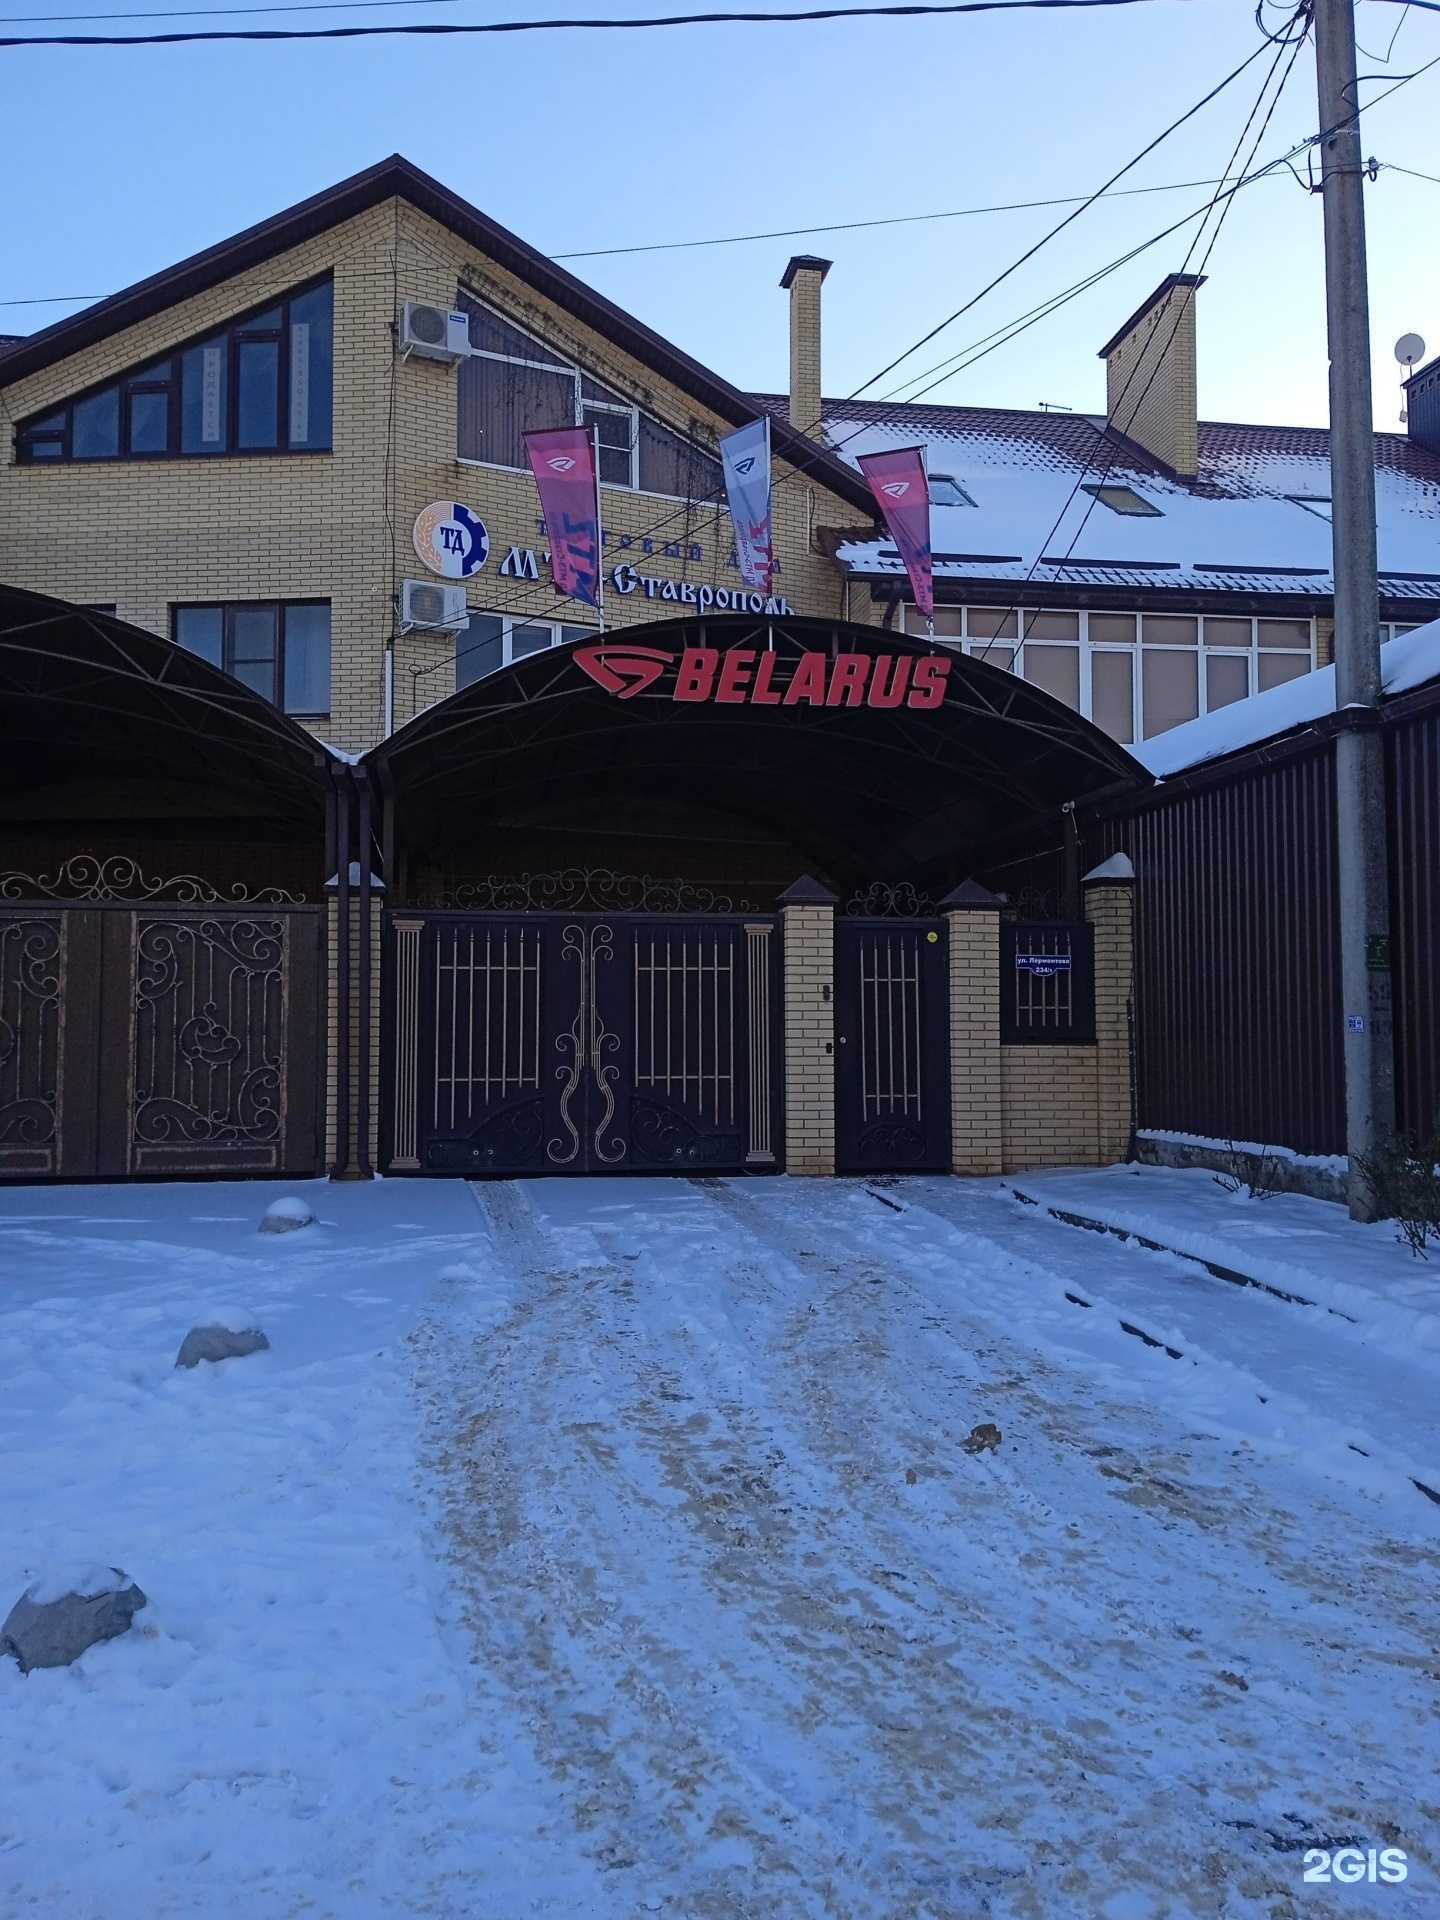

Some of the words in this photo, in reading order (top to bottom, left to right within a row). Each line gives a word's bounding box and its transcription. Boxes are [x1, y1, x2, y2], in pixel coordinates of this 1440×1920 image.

[439, 526, 466, 557] ТД
[499, 545, 796, 616] М-Ставрополь
[671, 646, 952, 710] BELARUS
